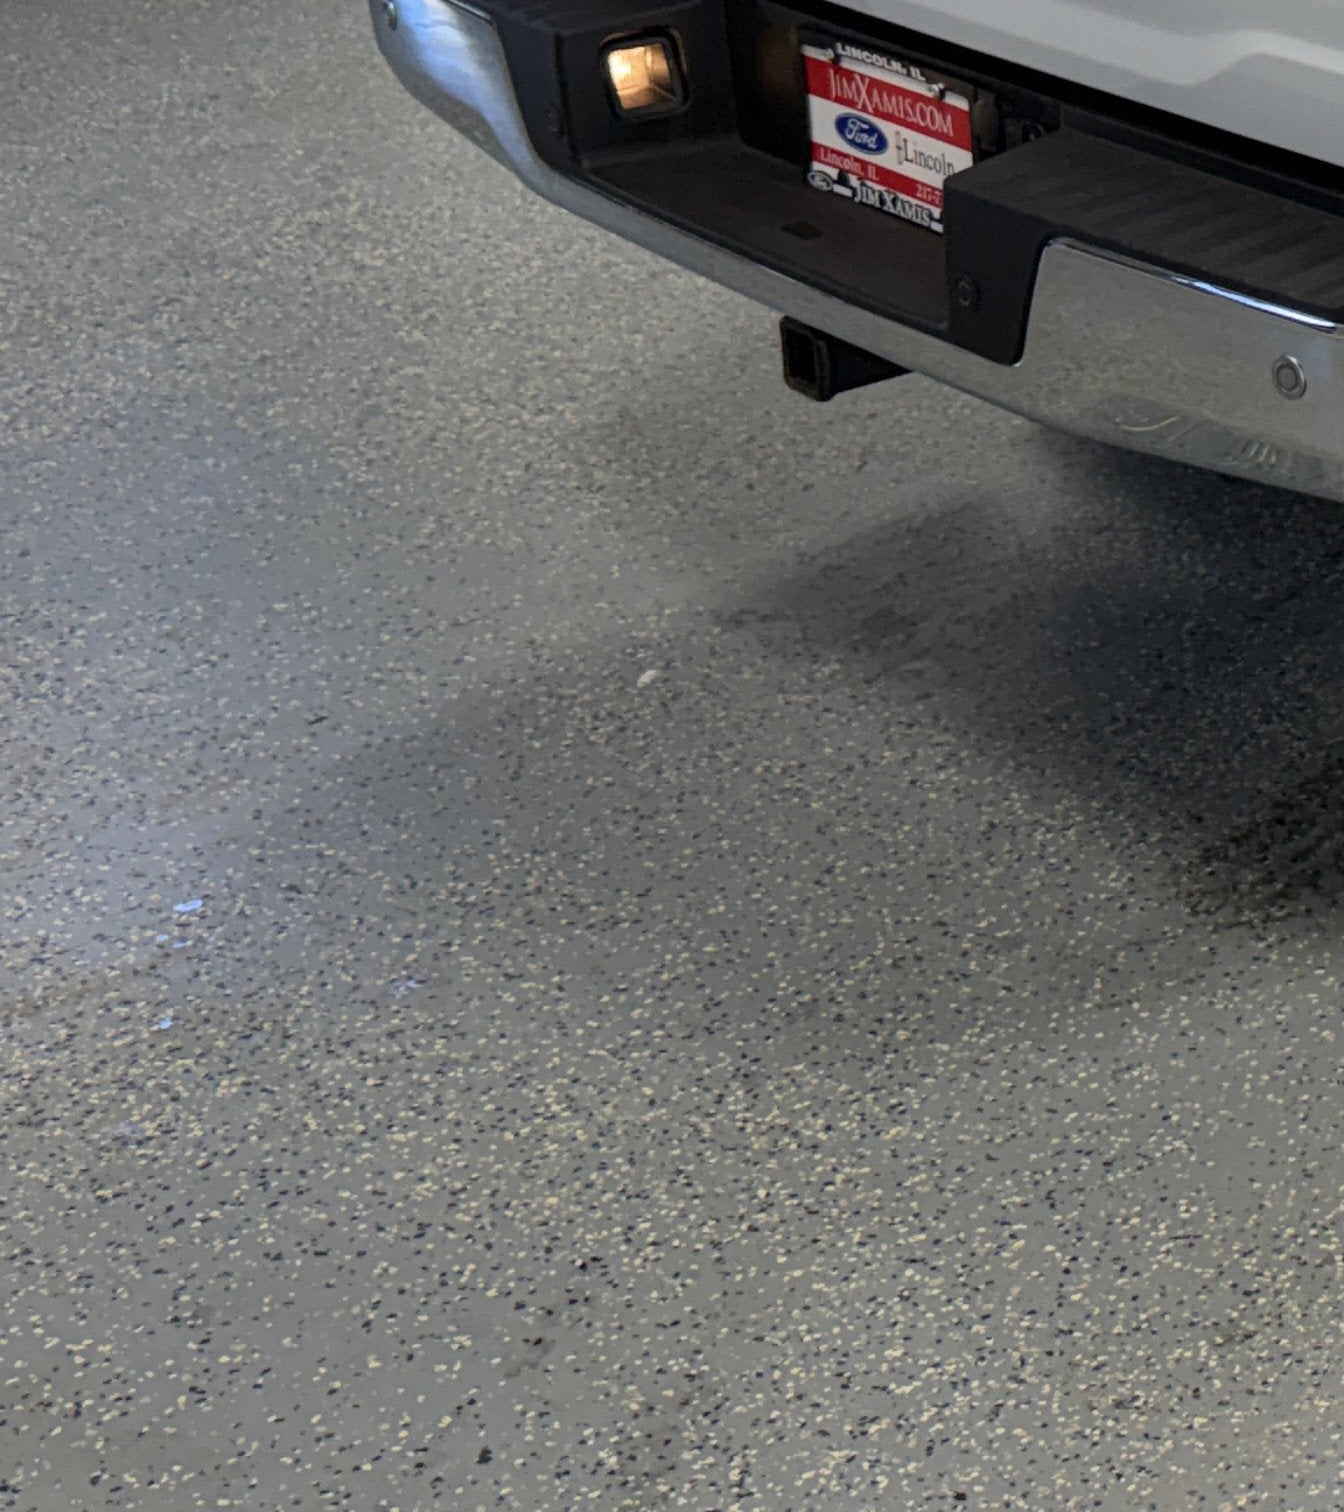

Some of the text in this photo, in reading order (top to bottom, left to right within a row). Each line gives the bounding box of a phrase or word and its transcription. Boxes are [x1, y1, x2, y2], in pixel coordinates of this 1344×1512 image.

[911, 65, 926, 81] IL
[828, 68, 954, 136] JIMXAMIS.COM
[843, 117, 879, 150] Ford
[867, 165, 880, 181] IL
[902, 138, 955, 176] Lincoln
[854, 183, 932, 226] JIM XAMIS
